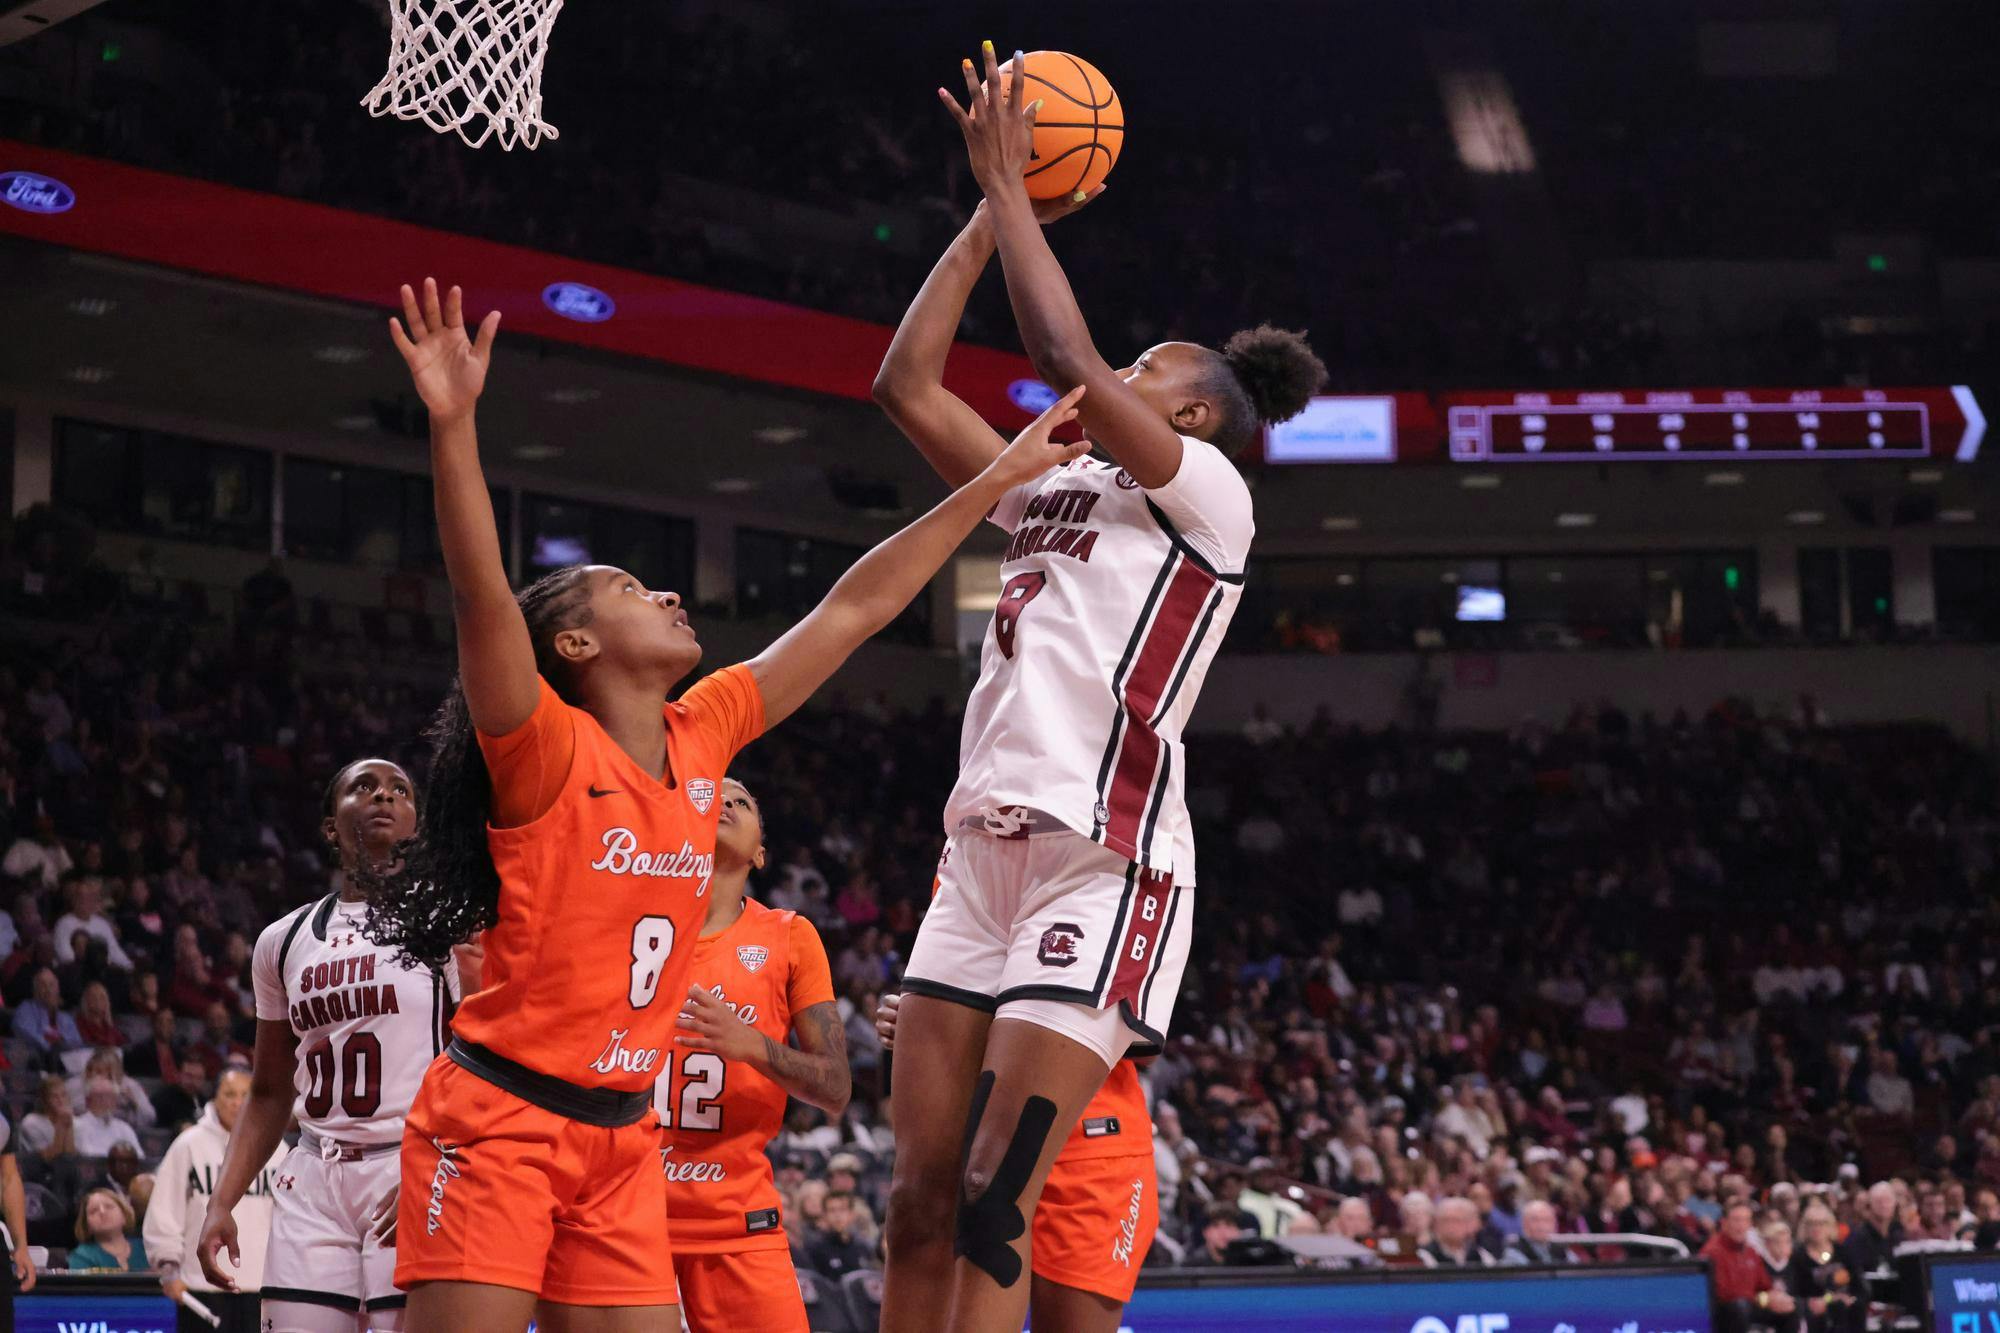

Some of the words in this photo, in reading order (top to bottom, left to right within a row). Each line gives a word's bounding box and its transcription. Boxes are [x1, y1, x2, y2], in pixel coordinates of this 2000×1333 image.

[6, 176, 59, 207] Ford
[1004, 525, 1100, 563] AROLINA
[996, 571, 1047, 661] 8
[689, 789, 714, 799] MAC
[591, 827, 713, 897] Bowling
[300, 952, 377, 994] SOUTH
[627, 914, 677, 1010] 8
[739, 953, 766, 962] MAC
[290, 983, 400, 1032] CAROLINA
[304, 1031, 382, 1119] 00
[589, 1028, 662, 1075] Gree
[653, 1050, 726, 1132] 12
[427, 1135, 461, 1237] lcons
[1112, 1176, 1144, 1268] Falcons
